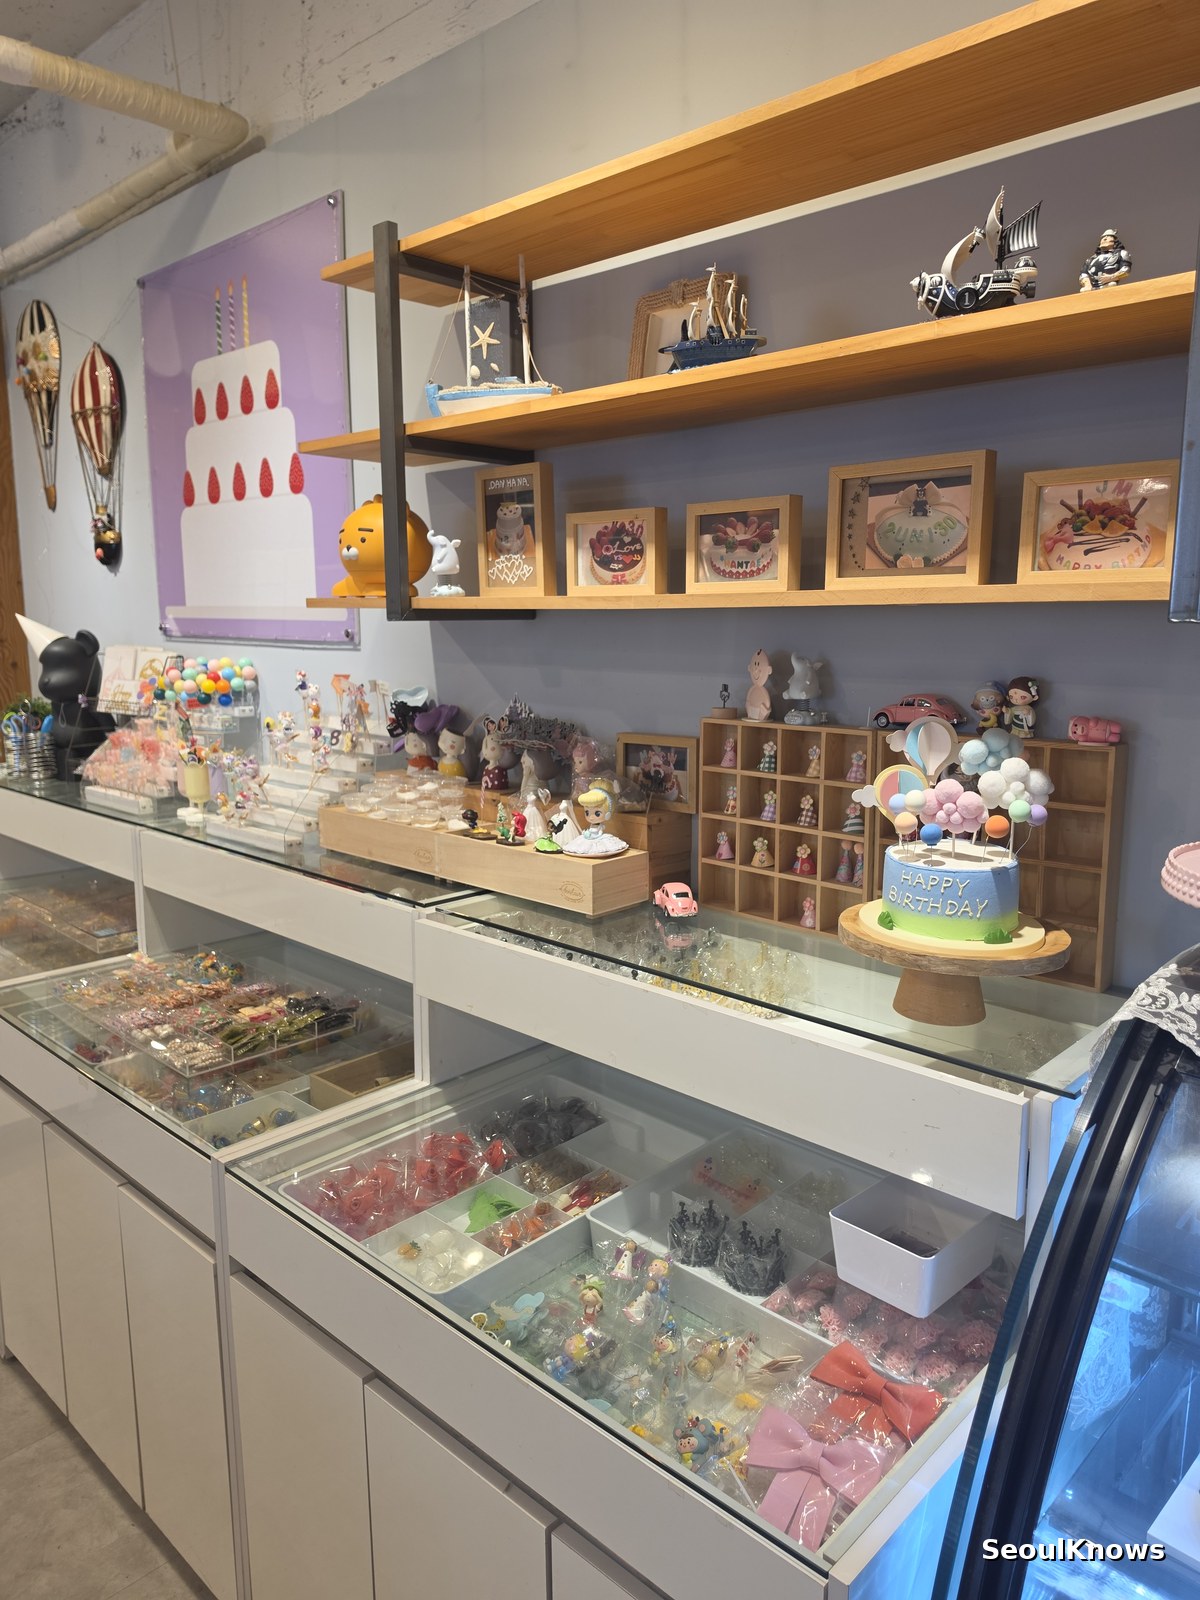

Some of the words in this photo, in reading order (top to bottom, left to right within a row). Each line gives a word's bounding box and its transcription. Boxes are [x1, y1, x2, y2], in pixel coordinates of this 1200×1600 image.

[964, 291, 971, 306] 1
[612, 541, 642, 553] Love
[901, 869, 970, 897] HAPPY
[888, 885, 989, 919] BIRTHDAY
